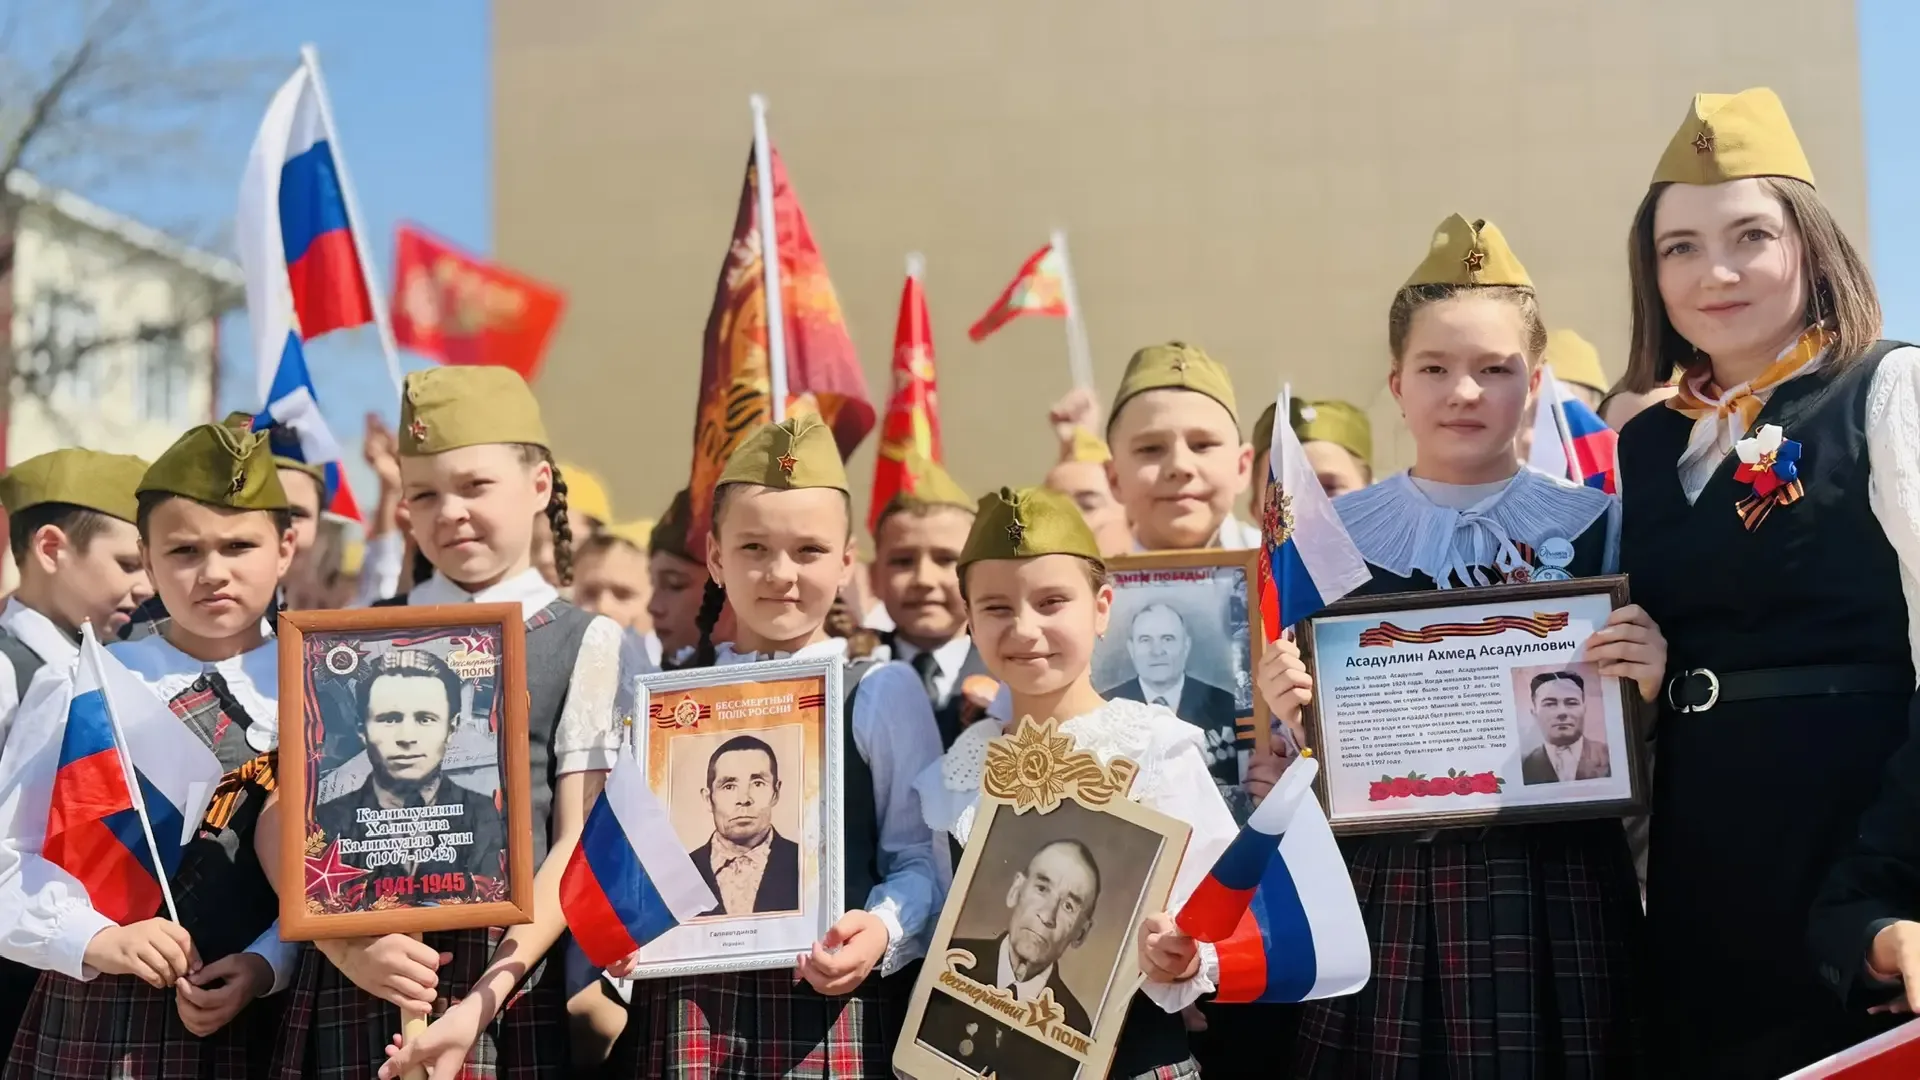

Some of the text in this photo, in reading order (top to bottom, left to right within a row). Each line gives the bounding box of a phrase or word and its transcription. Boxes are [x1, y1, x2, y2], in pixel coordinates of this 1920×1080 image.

[1346, 638, 1576, 668] Асадуллин Ахмед Асадуллович
[462, 667, 492, 677] ПОЛК
[716, 693, 794, 711] БЕССМЕРТНЫЙ
[718, 706, 792, 721] ПОЛК РОССИИ
[356, 804, 464, 822] Калимуллин
[366, 820, 449, 836] Халиулла
[338, 832, 473, 854] Калимулла улы
[366, 848, 456, 868] (1907-1942)
[374, 874, 465, 897] 1941-1945
[939, 969, 1028, 1022] бессмертный
[1050, 1026, 1092, 1056] ПОЛК
